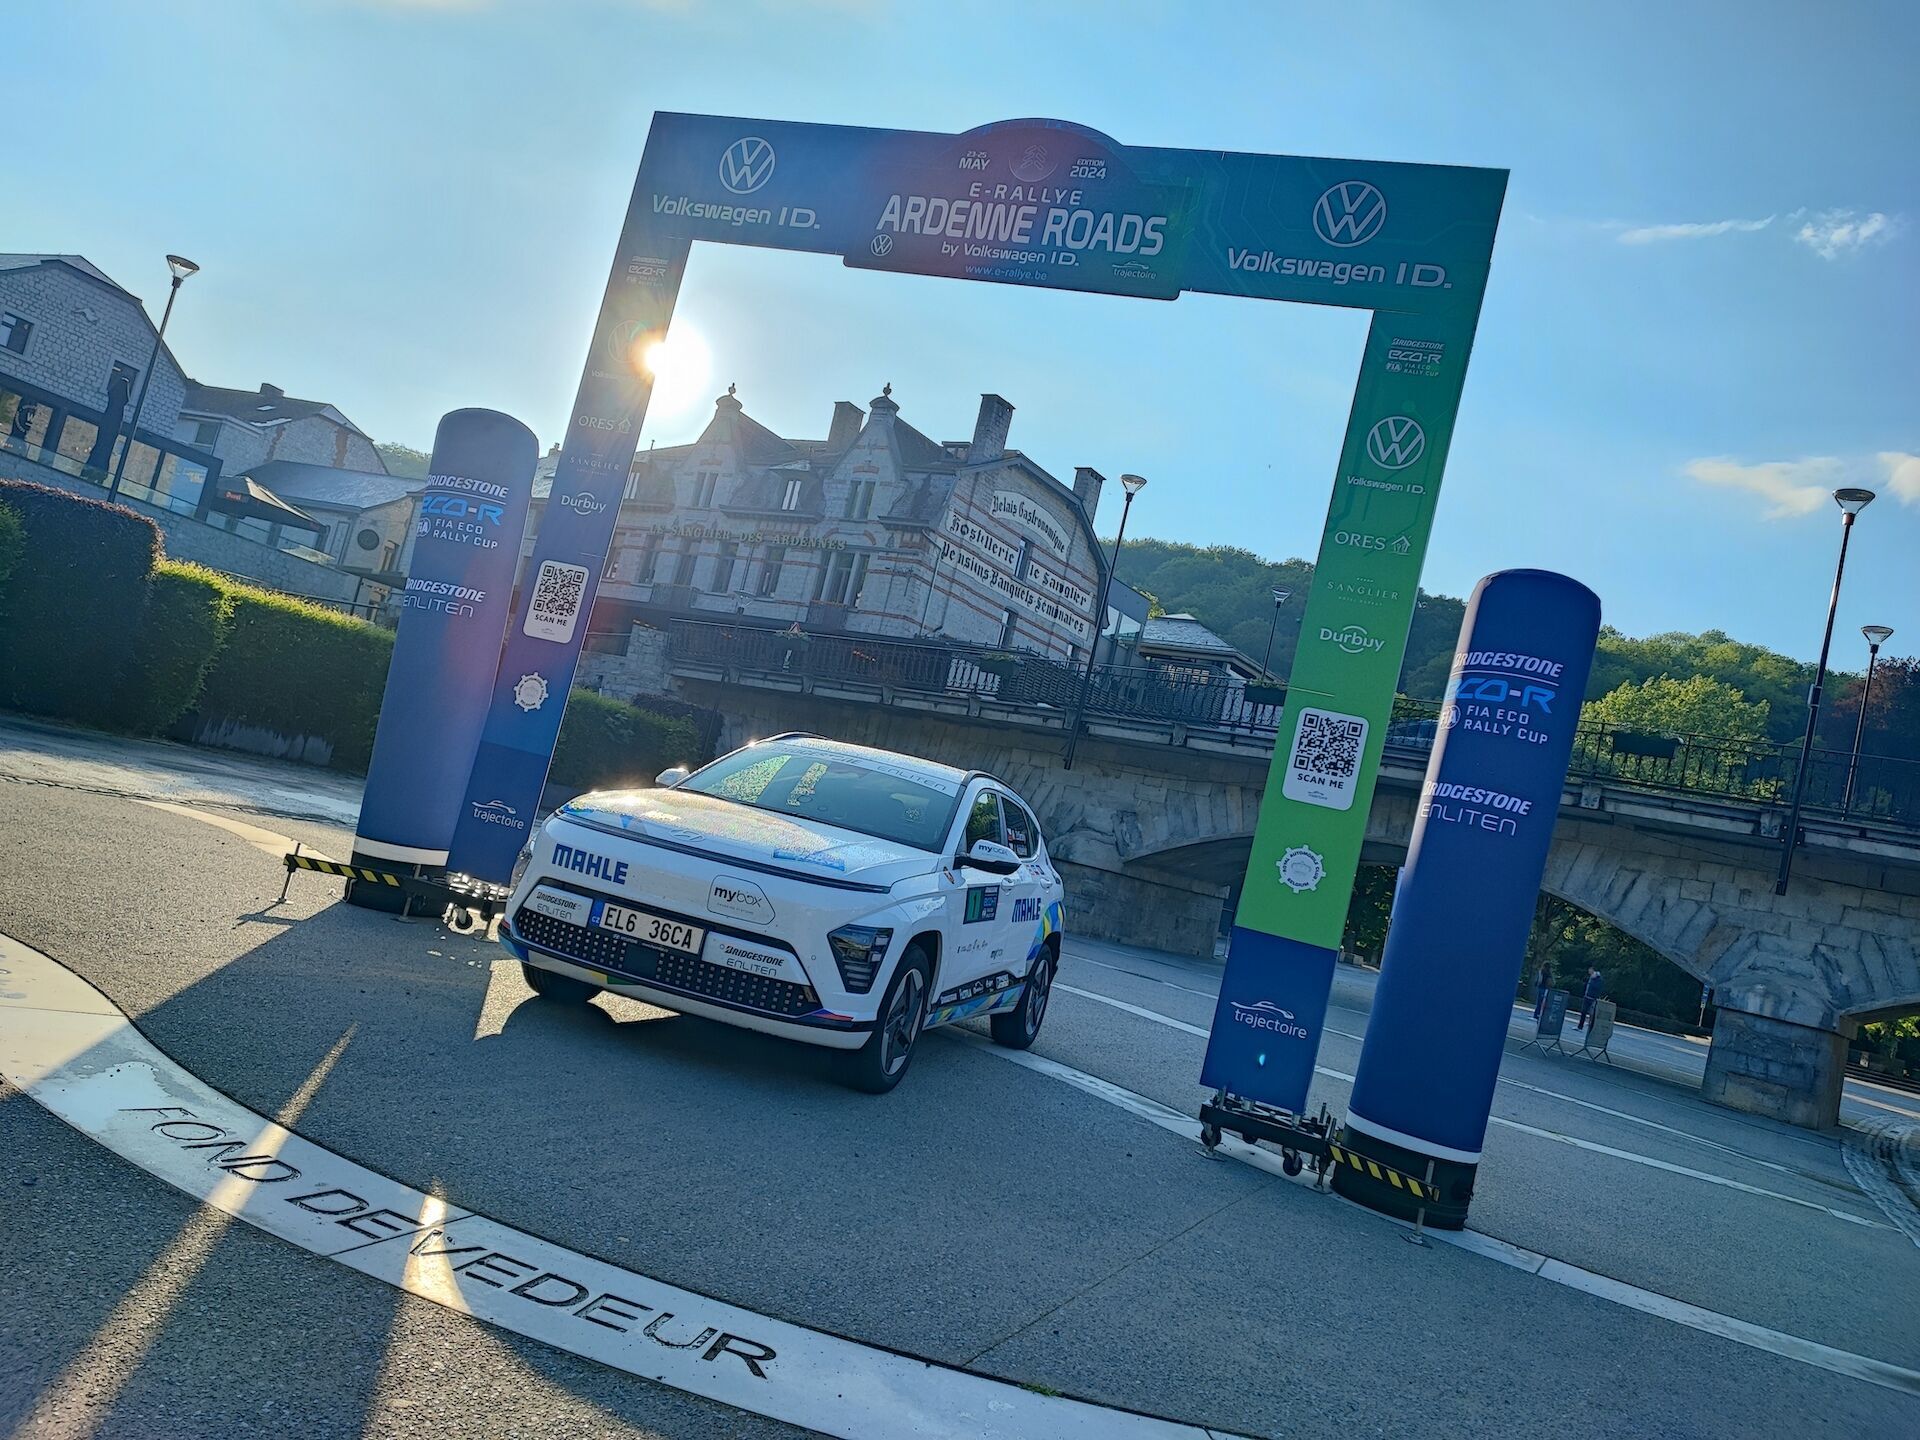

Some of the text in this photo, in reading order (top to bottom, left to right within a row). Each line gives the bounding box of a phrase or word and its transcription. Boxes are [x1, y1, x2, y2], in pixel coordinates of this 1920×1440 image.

[959, 157, 991, 171] MAY
[967, 150, 987, 159] 23-25
[1076, 158, 1106, 167] EDITION
[1069, 165, 1107, 179] 2024
[969, 182, 1083, 205] E-RALLYE
[652, 194, 771, 226] Volkswagen
[876, 194, 1168, 256] ARDENNE ROADS
[941, 241, 959, 257] by
[964, 243, 1046, 265] Volkswagen
[965, 264, 1048, 281] www.e-rallye.be
[1113, 268, 1157, 280] trajectoire
[1227, 247, 1386, 285] Volkswagen
[1391, 337, 1445, 350] BRIDGESTONE
[1425, 370, 1440, 378] CUP
[578, 414, 615, 431] ORES
[1346, 475, 1404, 492] Volkswagen
[561, 494, 607, 514] Durbuy
[435, 518, 483, 535] FIA ECO
[992, 495, 1065, 553] Relais Gastronomique
[433, 529, 499, 550] RALLY CUP
[738, 530, 765, 543] DES
[949, 514, 1015, 564] Hostellerie
[1334, 531, 1387, 551] ORES
[1327, 581, 1400, 600] SANGLIER
[534, 613, 568, 627] SCAN ME
[1319, 626, 1386, 652] Durbuy
[1466, 704, 1530, 725] FIA ECO
[1463, 719, 1549, 745] RALLY CUP
[1297, 772, 1345, 790] SCAN ME
[473, 806, 525, 830] trajectoire
[551, 843, 629, 885] MAHLE
[536, 891, 579, 910] BRIDGESTONE
[714, 886, 762, 908] mybox
[537, 903, 572, 920] ENLITEN
[592, 915, 601, 924] CZ
[1011, 897, 1041, 923] MAHLE
[604, 906, 638, 933] EL6
[648, 919, 693, 949] 36CA
[725, 945, 785, 967] BRIDGESTONE
[726, 957, 777, 977] ENLITEN
[1234, 1008, 1308, 1040] trajectoire
[118, 1107, 777, 1380] FOND DE VEDEUR
